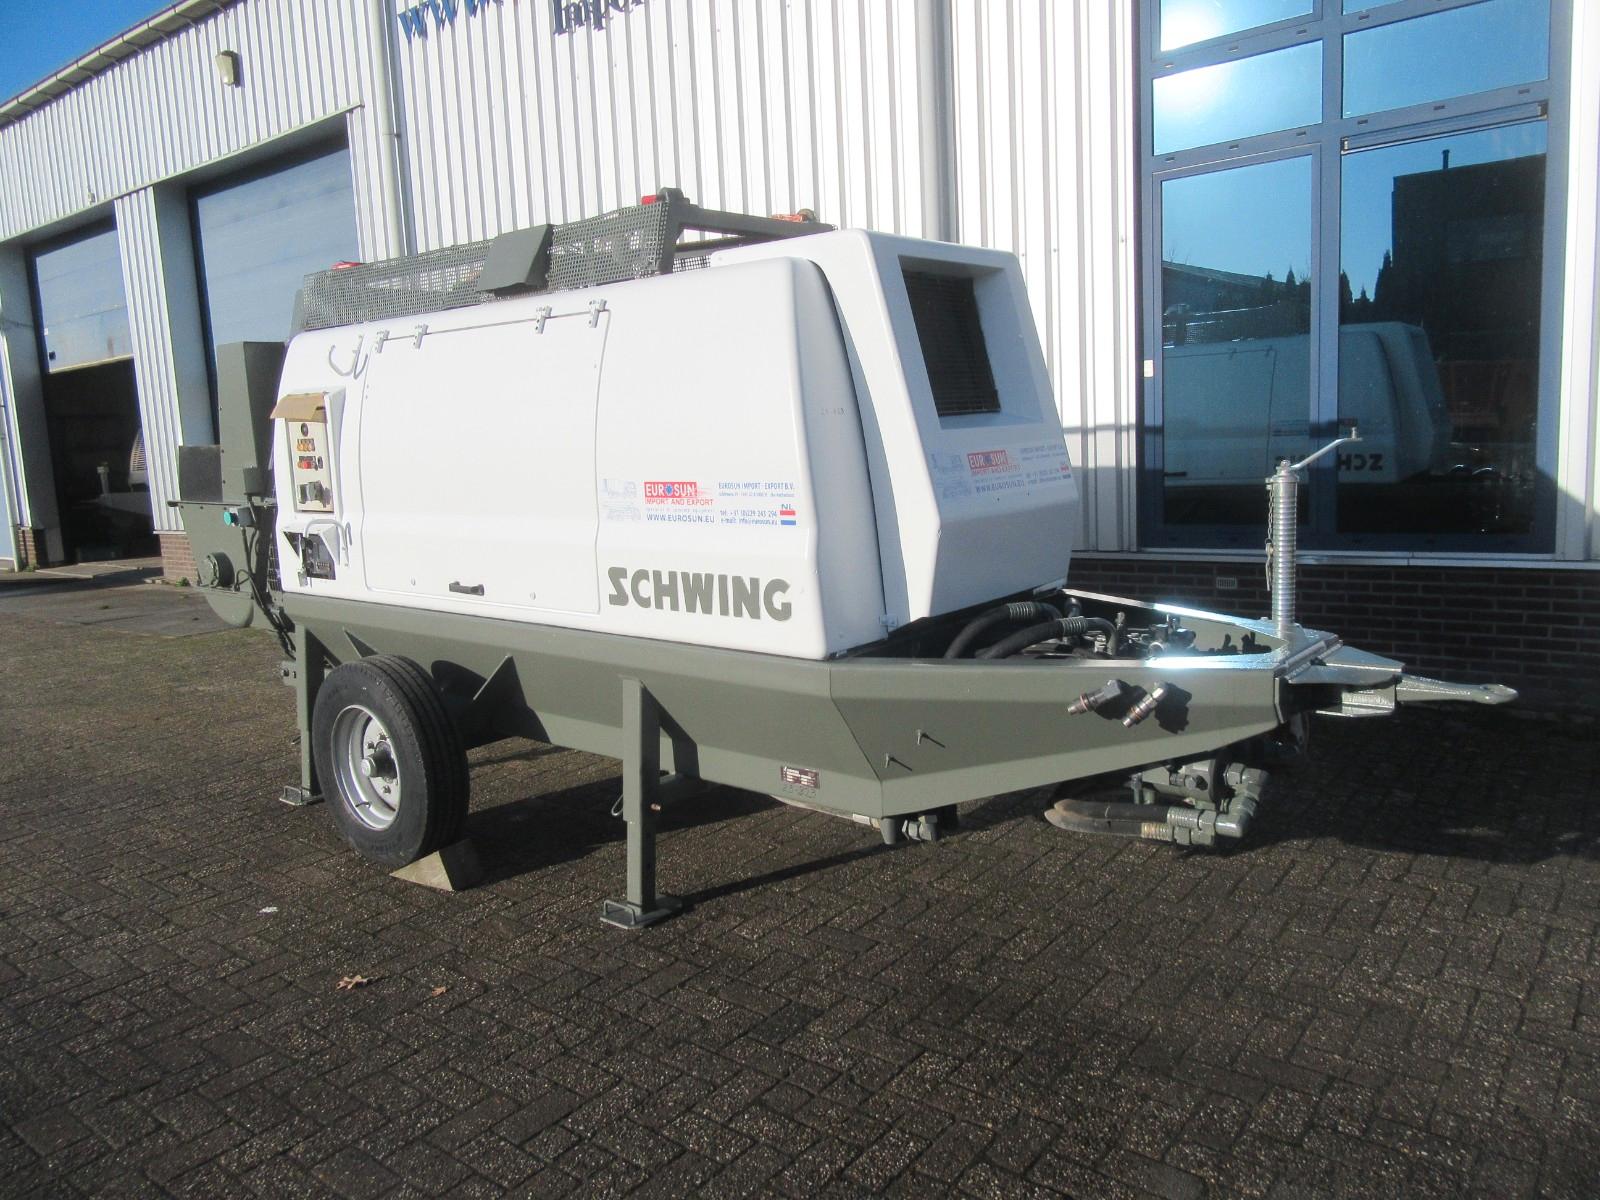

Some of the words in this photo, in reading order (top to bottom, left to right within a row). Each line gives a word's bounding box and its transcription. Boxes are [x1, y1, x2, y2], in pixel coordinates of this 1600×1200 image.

[645, 483, 696, 497] EUROSUN
[687, 498, 714, 506] EXPORT
[608, 566, 792, 622] SCHWING
